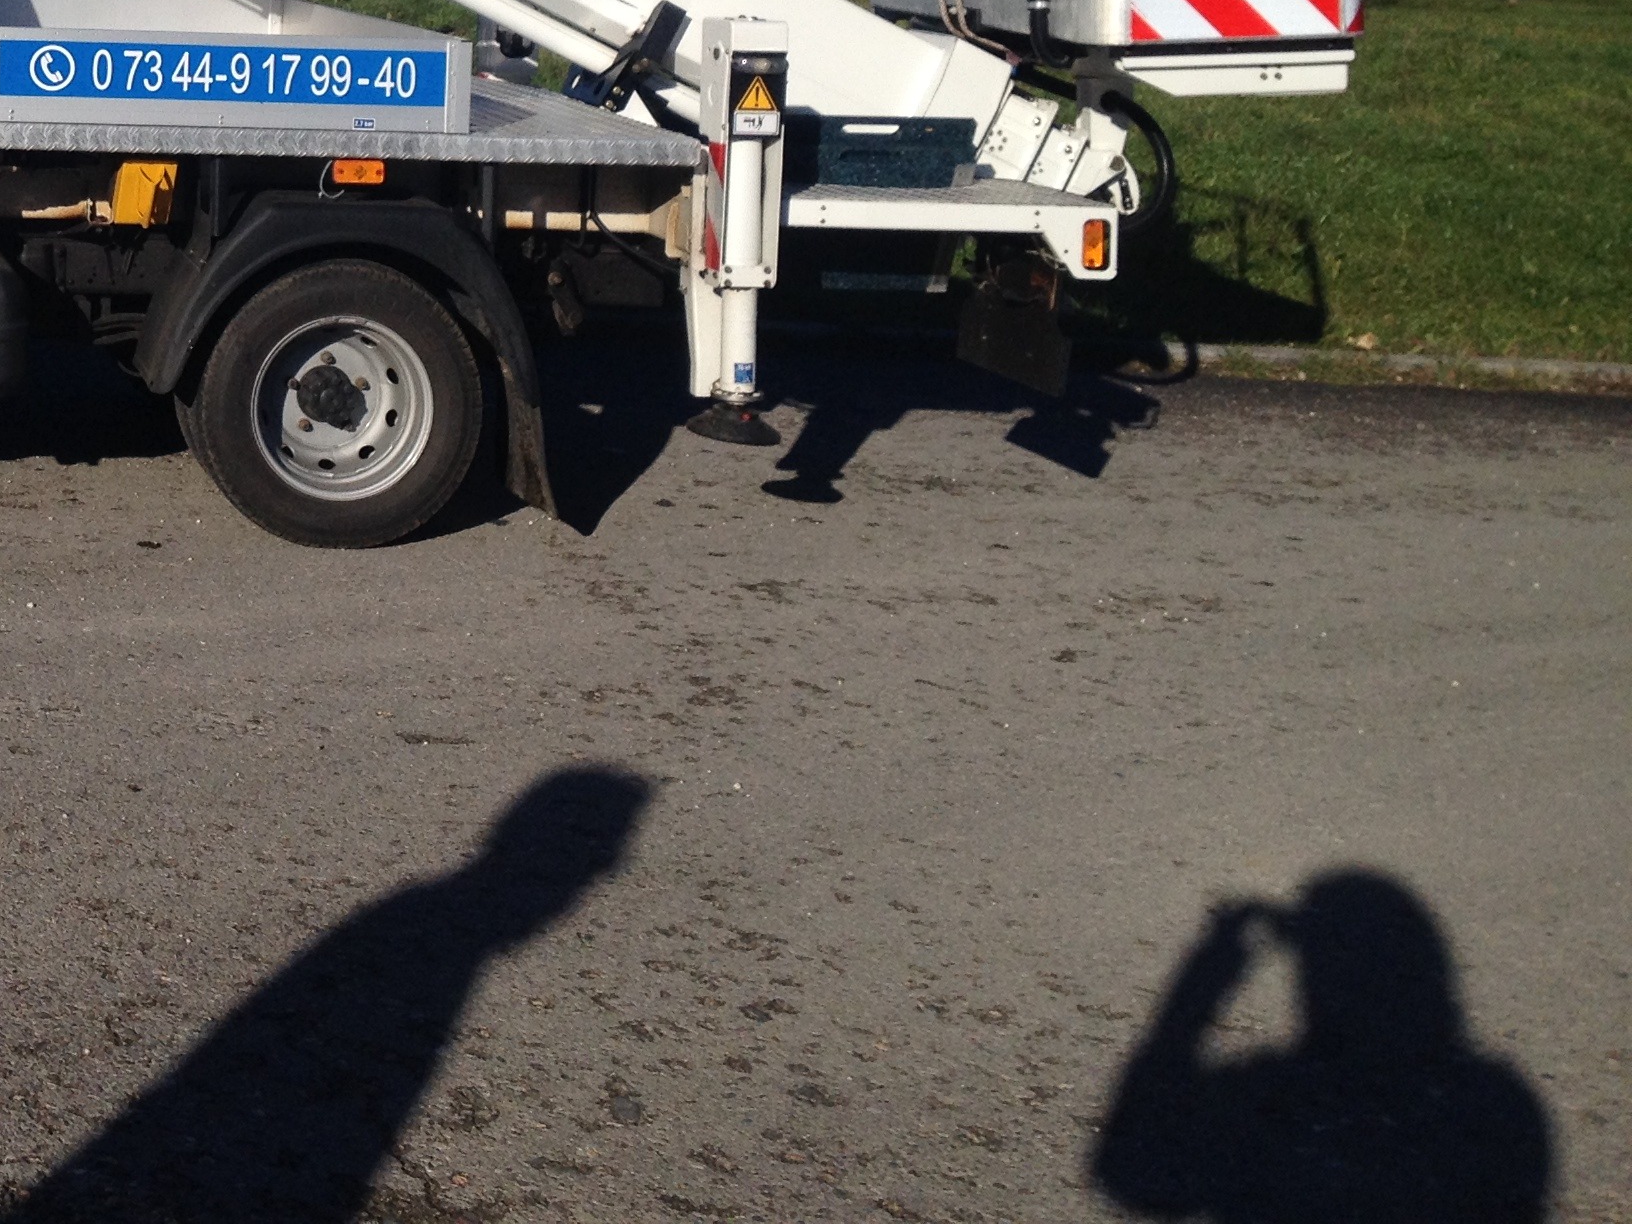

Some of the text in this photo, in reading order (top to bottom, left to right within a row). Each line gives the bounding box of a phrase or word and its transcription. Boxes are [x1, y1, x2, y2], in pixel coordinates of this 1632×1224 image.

[92, 49, 113, 91] 0
[123, 50, 163, 92] 73
[262, 53, 301, 95] 17
